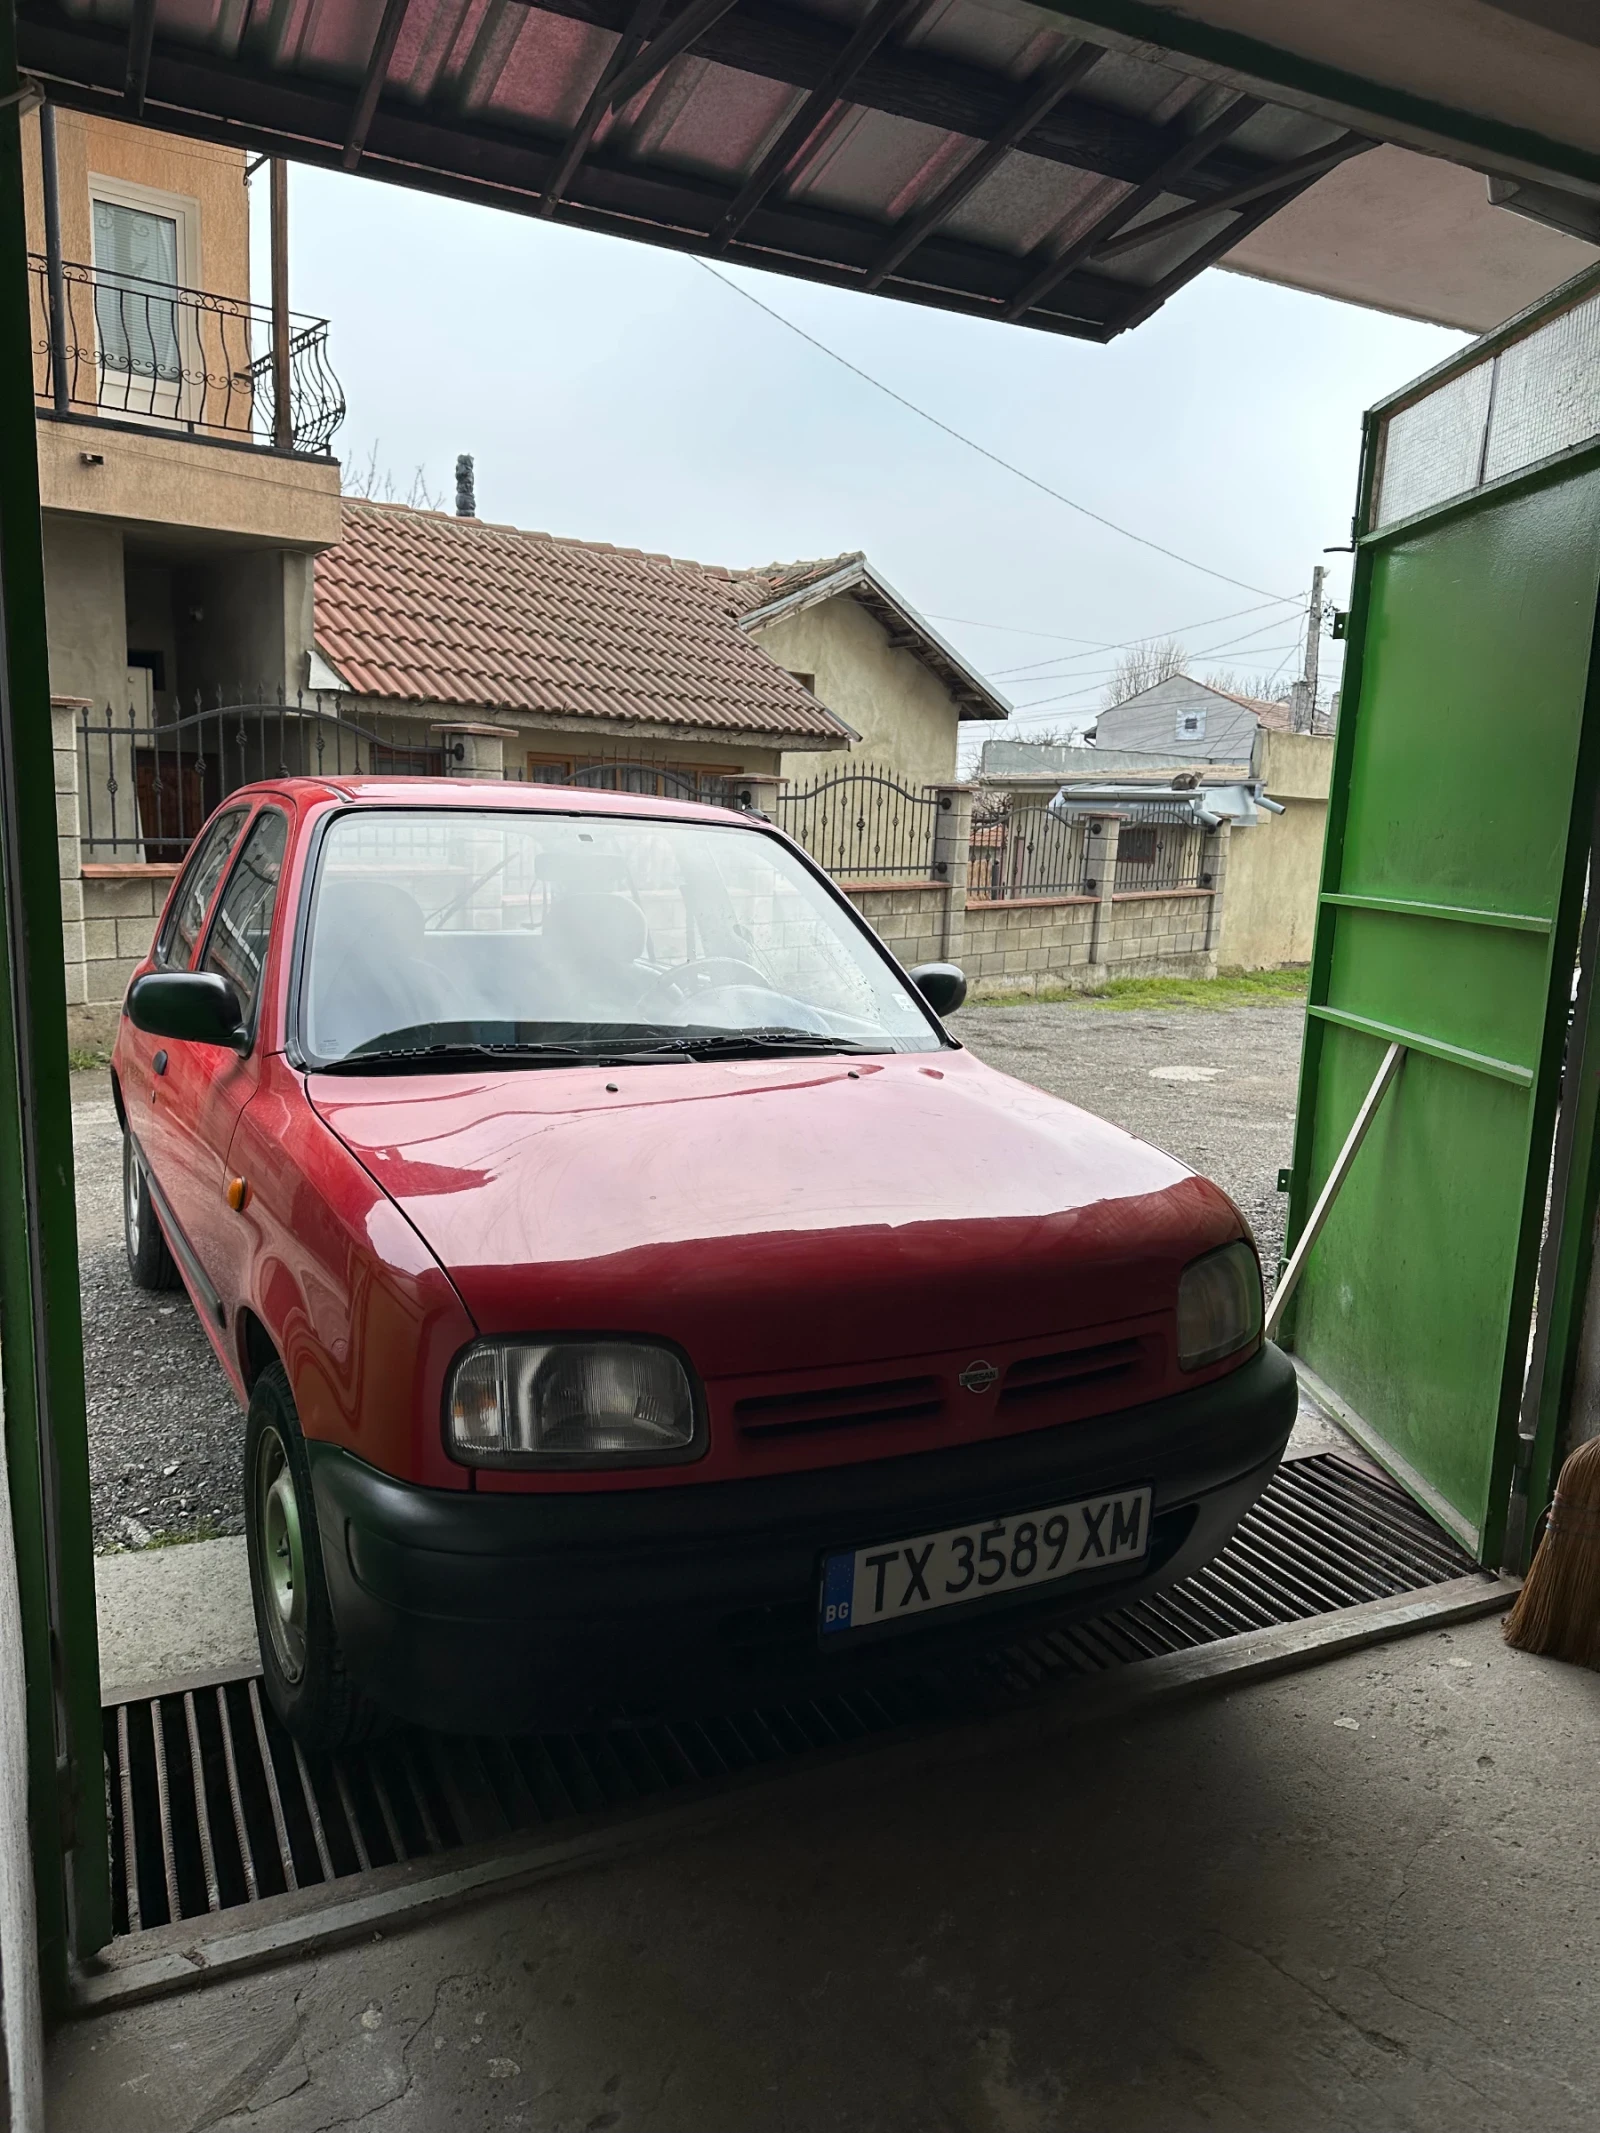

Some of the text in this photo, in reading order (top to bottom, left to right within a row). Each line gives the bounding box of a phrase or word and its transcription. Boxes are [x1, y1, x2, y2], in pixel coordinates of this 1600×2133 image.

[866, 1497, 1142, 1613] TX 3589 XM
[825, 1601, 849, 1623] BG
